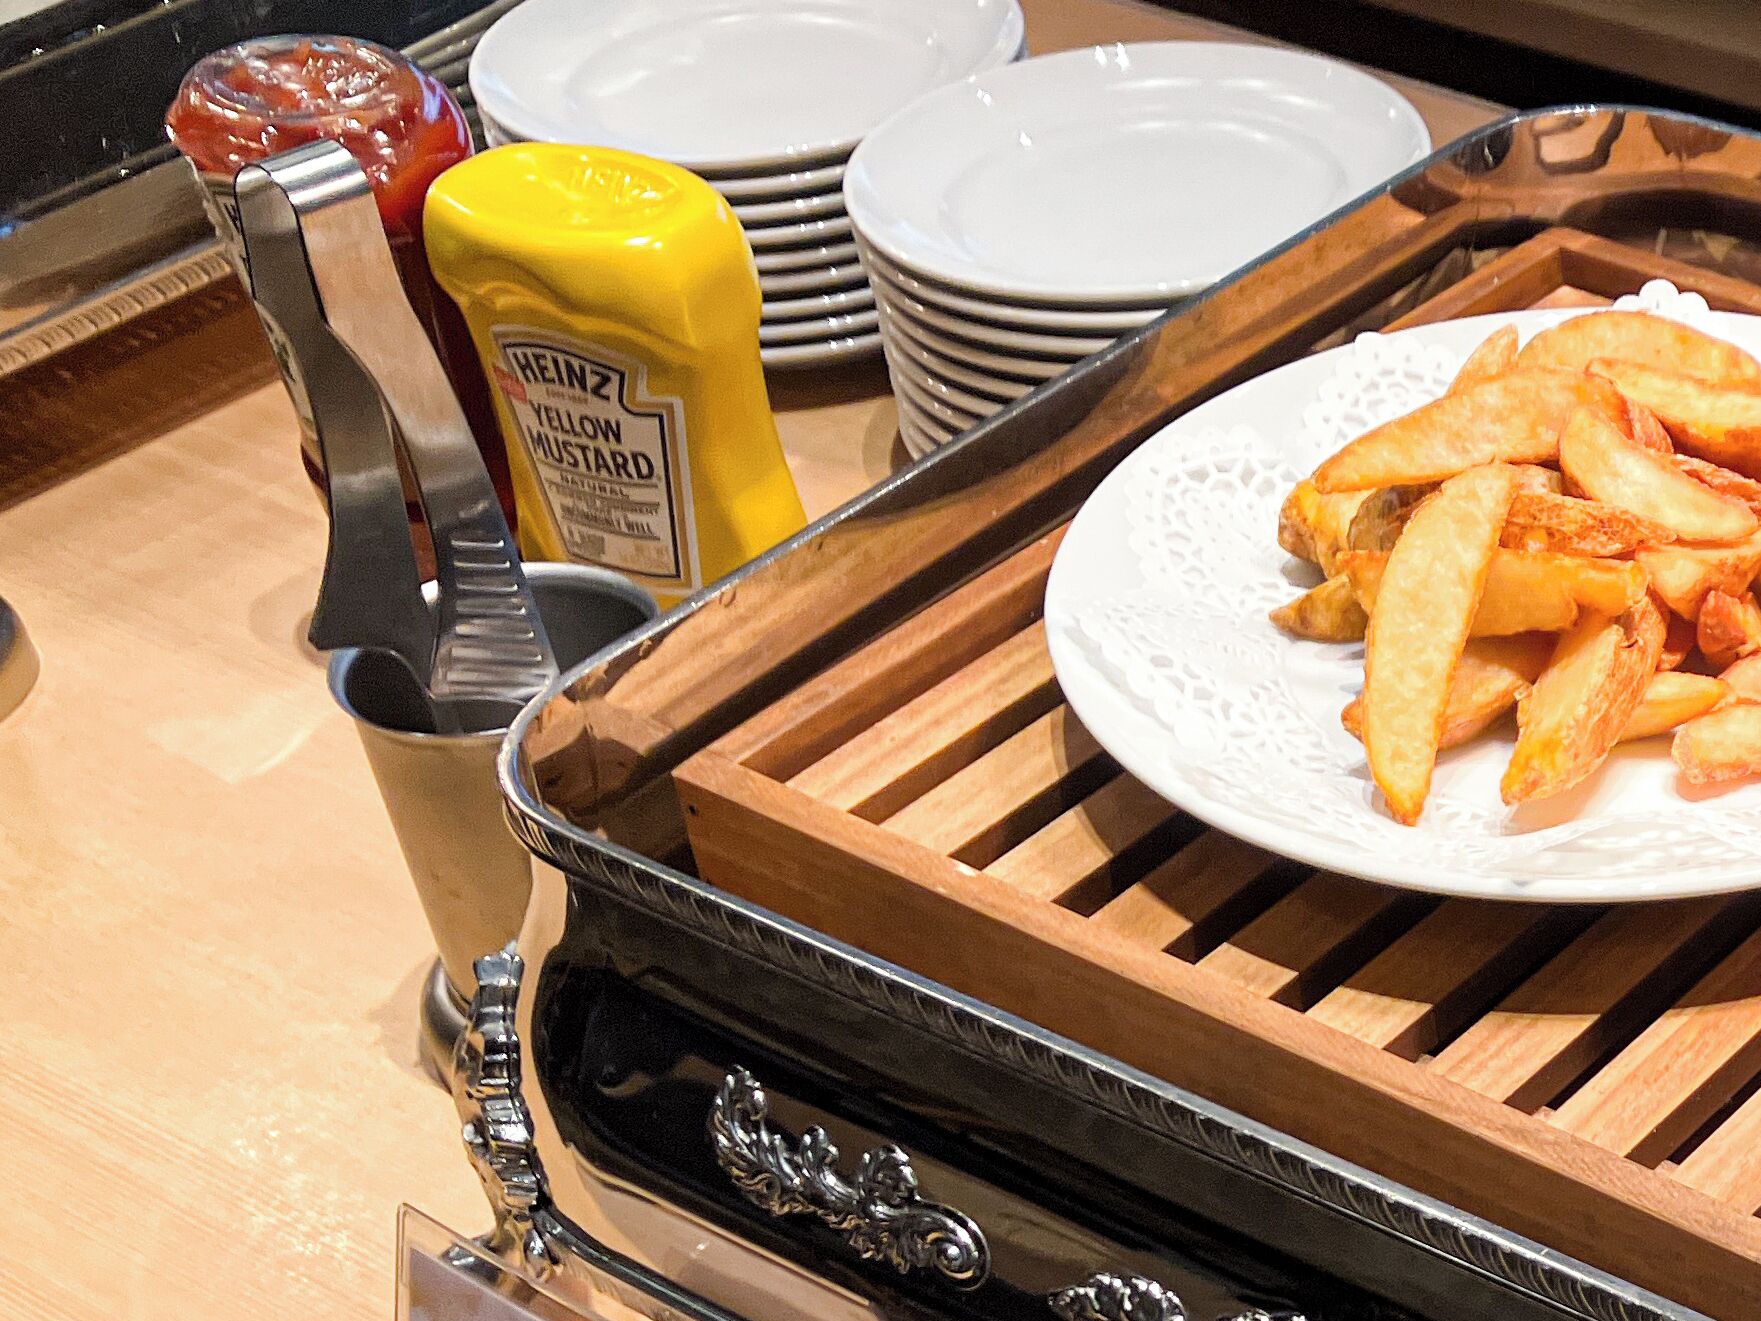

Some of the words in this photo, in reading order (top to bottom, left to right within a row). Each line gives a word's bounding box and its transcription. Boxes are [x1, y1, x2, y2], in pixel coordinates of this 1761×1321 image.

[512, 351, 613, 401] HEINZ
[529, 400, 623, 445] YELLOW
[527, 424, 655, 481] MUSTARD
